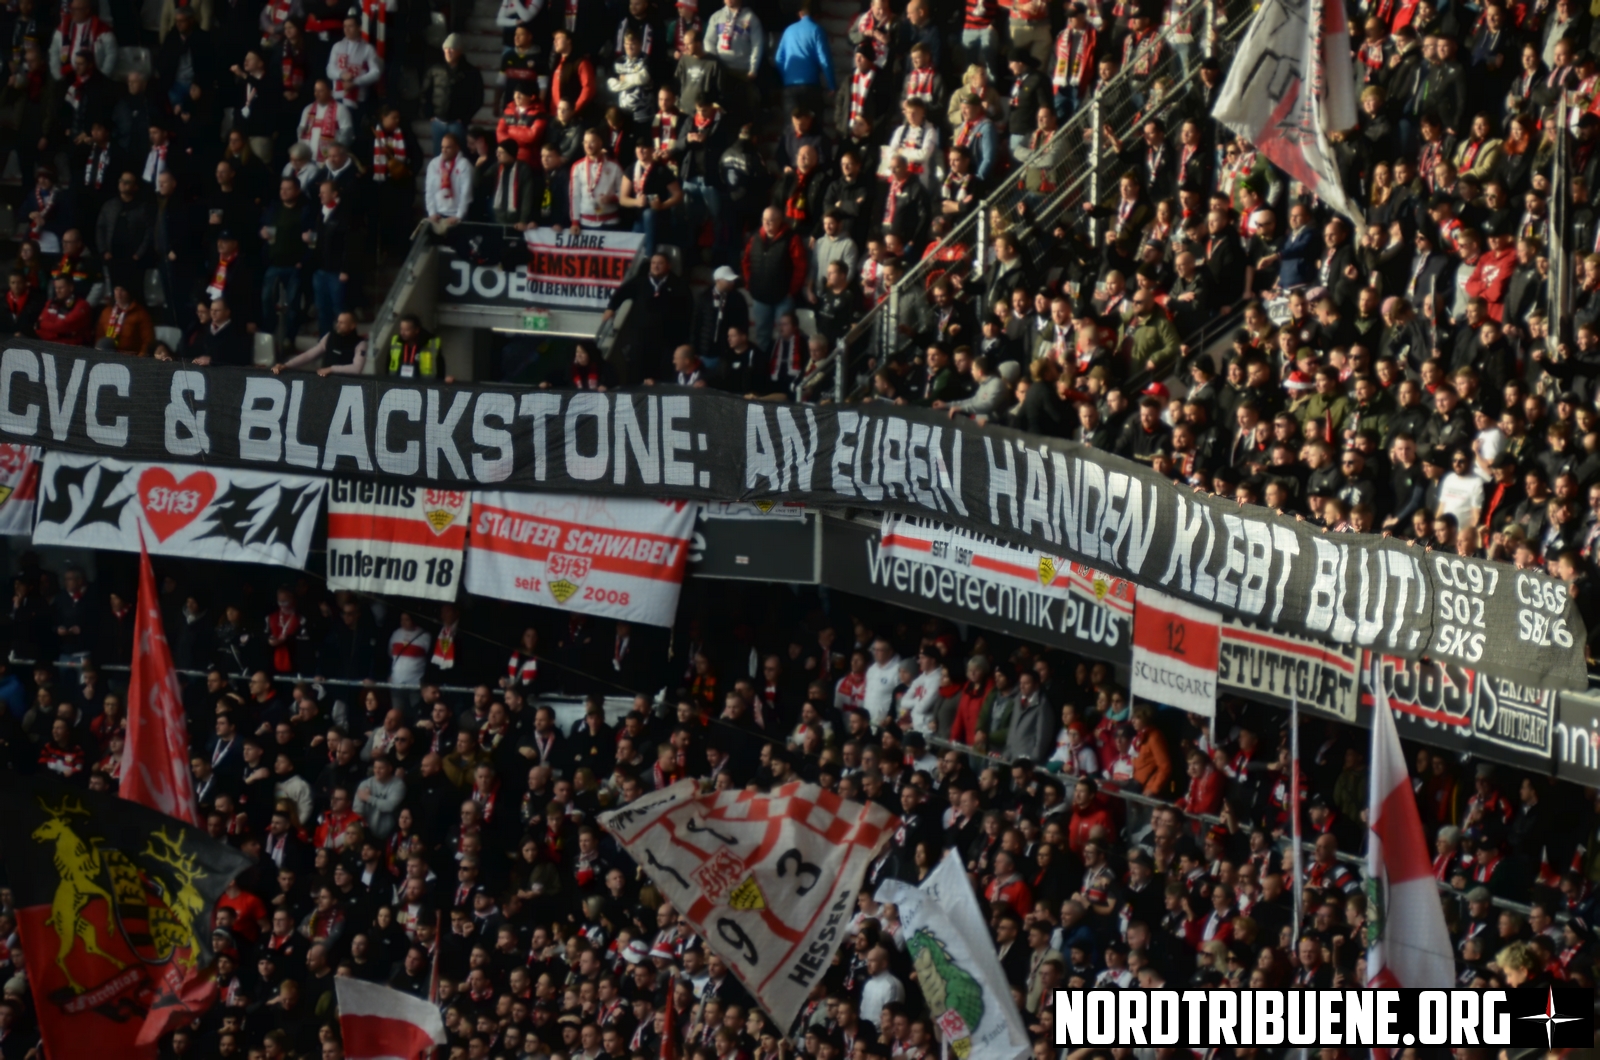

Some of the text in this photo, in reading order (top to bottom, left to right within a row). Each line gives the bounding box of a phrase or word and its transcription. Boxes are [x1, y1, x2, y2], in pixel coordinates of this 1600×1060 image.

[556, 233, 606, 250] 5 JAHRE
[0, 348, 131, 448] CVC
[164, 370, 210, 456] &
[239, 376, 711, 488] BLACKSTONE:
[746, 403, 819, 492] AN
[831, 410, 969, 517] EUREN
[984, 436, 1157, 575] HÄNDEN
[1160, 494, 1300, 624] KLEBT
[1305, 536, 1426, 650] BLUT!
[476, 511, 561, 549] STAUFER
[563, 528, 681, 567] SCHWABEN
[330, 549, 454, 587] Inferno 18
[515, 576, 542, 592] seit
[1435, 556, 1499, 595] CC97
[583, 587, 630, 606] 2008
[866, 539, 1120, 648] Werbetechnik PLUS
[1440, 590, 1486, 629] S02
[1166, 620, 1186, 654] 12
[1436, 625, 1487, 662] SKS
[788, 890, 851, 988] HESSEN
